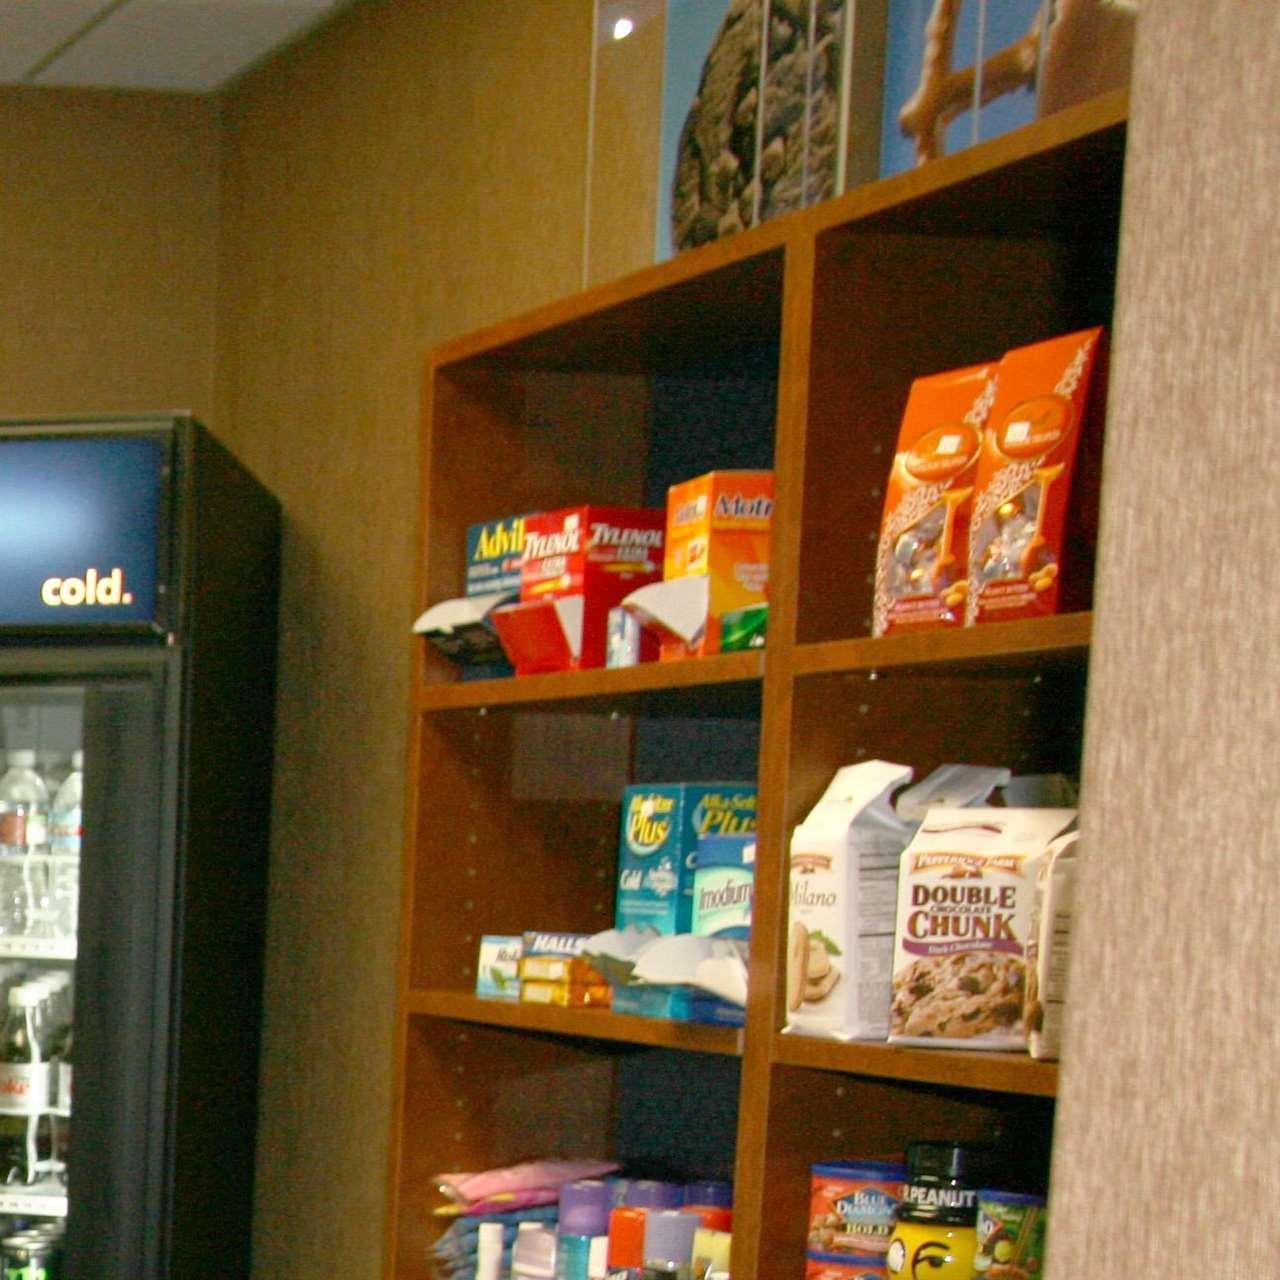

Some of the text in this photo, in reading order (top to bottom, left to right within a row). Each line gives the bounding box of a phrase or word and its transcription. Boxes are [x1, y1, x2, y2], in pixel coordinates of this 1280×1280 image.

[474, 517, 525, 560] Advil
[41, 568, 133, 606] cold.
[631, 814, 668, 845] Plus
[911, 885, 1016, 909] DOUBLE
[907, 910, 1018, 941] CHUNK
[910, 1186, 977, 1207] PEANUT
[845, 1222, 889, 1235] BOLD
